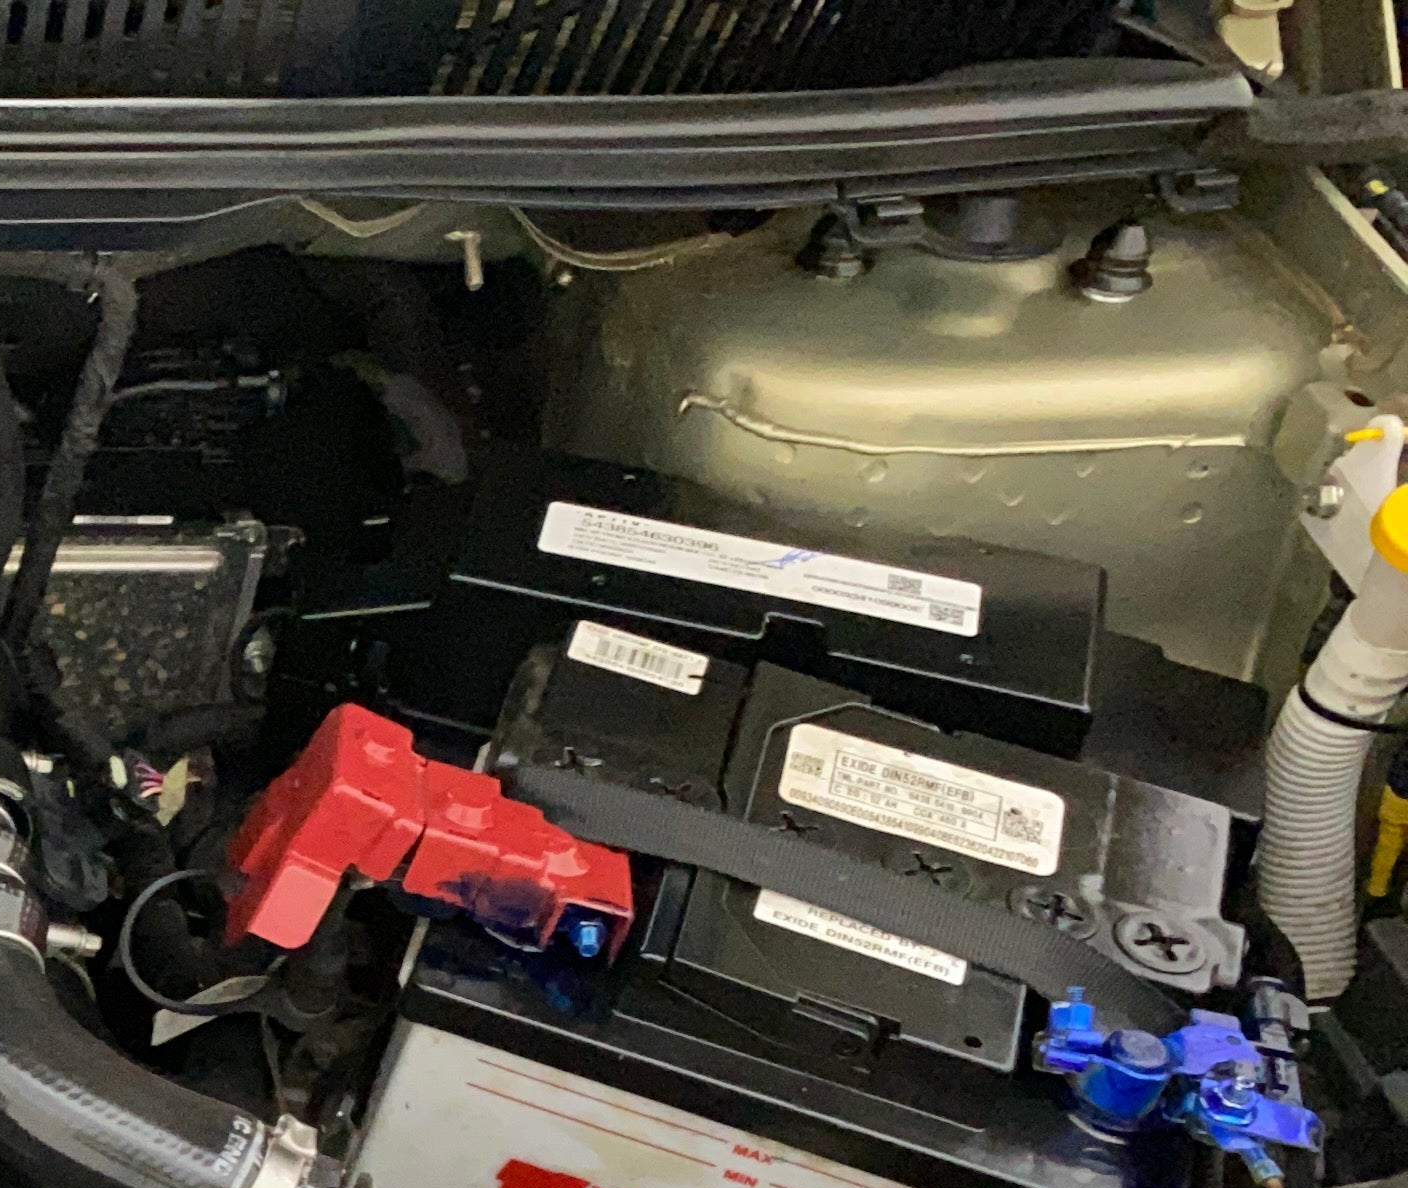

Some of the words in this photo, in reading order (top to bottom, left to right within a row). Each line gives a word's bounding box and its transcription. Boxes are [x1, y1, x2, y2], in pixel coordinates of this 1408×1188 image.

[840, 755, 877, 776] EXIDE
[772, 910, 820, 933] EXIDE
[825, 927, 951, 977] DIN52RMF(EFB)
[732, 1143, 775, 1166] MAX
[723, 1168, 759, 1188] MIN
